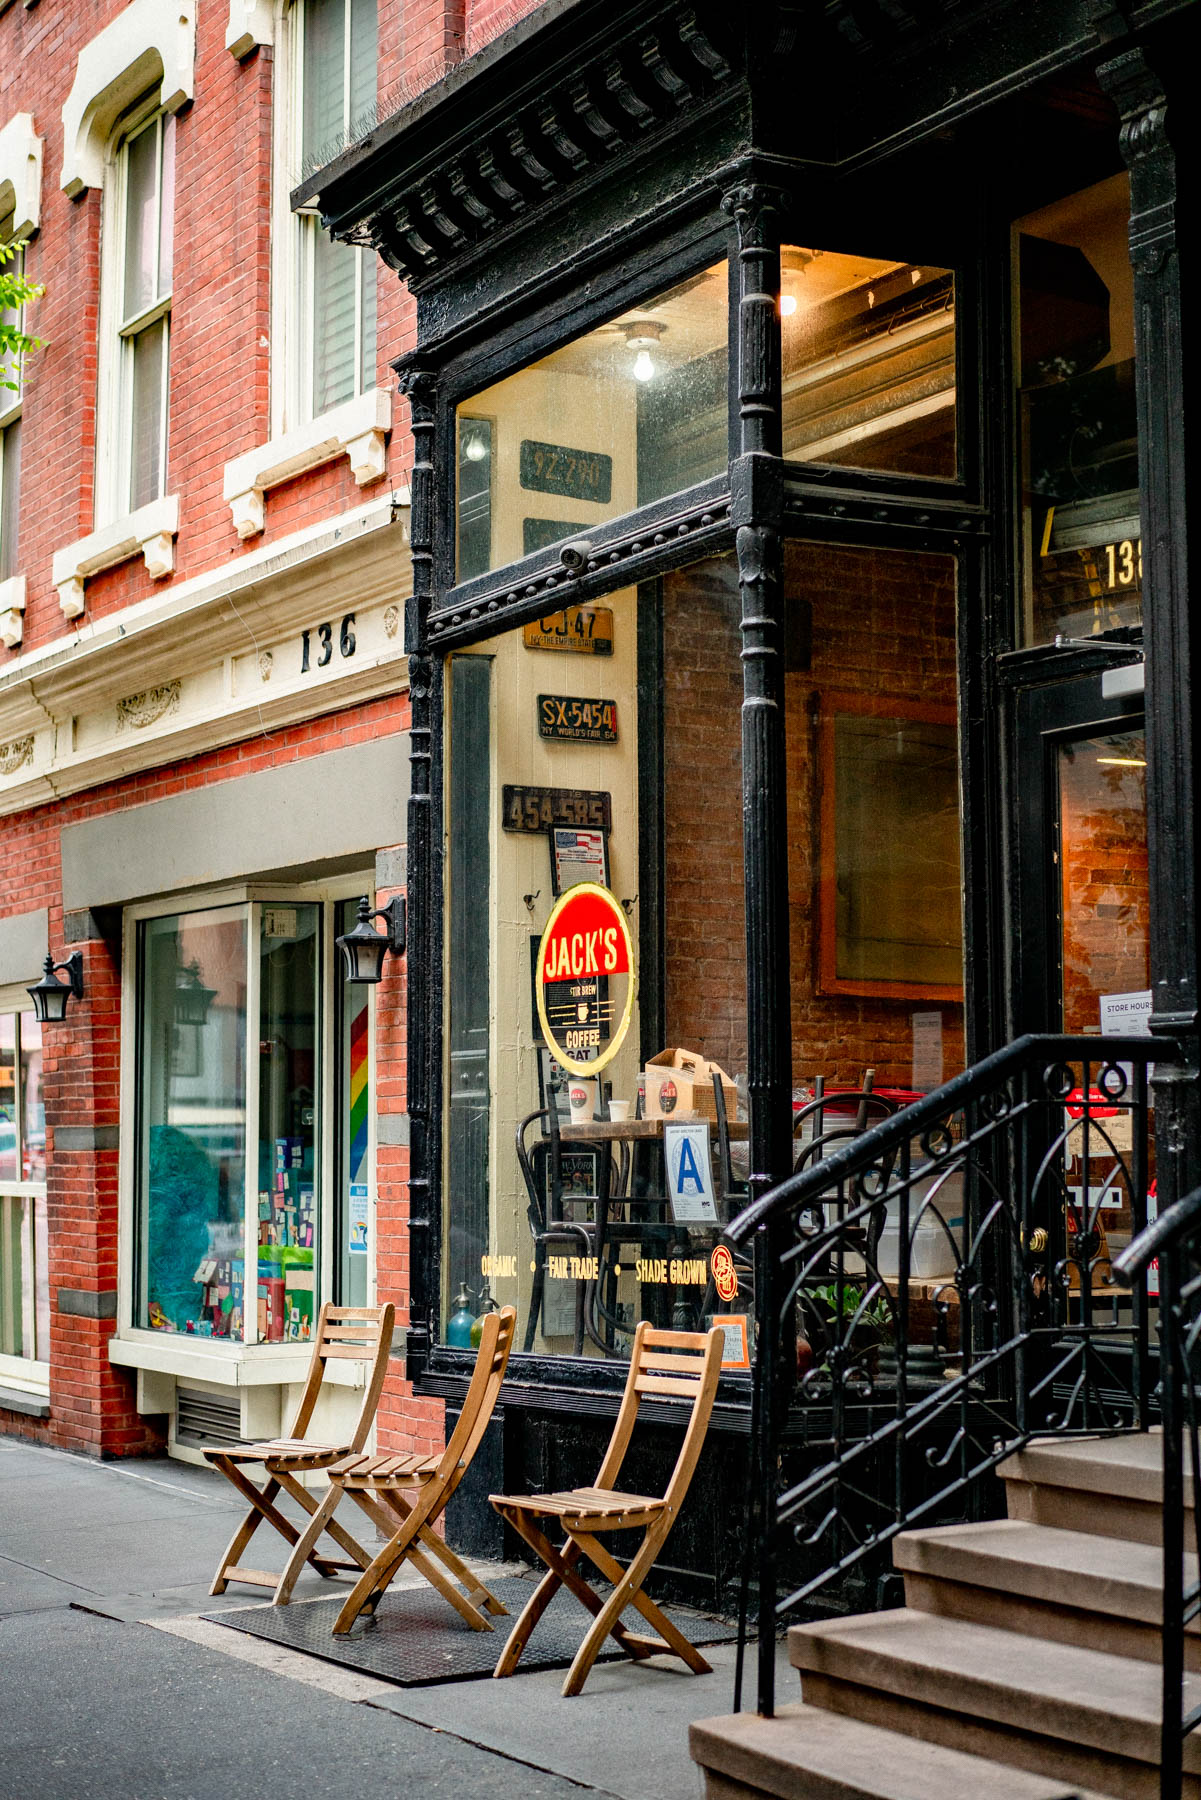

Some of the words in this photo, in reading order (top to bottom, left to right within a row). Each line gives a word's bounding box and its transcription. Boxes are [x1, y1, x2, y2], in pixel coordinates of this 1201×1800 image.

[301, 613, 356, 673] 136
[587, 729, 601, 738] FAIR
[546, 927, 618, 978] JACK'S
[570, 986, 581, 997] STIR
[581, 984, 596, 996] BREW
[1107, 1003, 1128, 1013] STORE
[566, 1029, 600, 1048] COFFEE
[677, 1138, 705, 1193] A
[481, 1256, 517, 1277] ORGANIC
[548, 1256, 568, 1279] FAIR
[569, 1257, 599, 1280] TRADE
[635, 1259, 668, 1283] SHADE
[669, 1260, 707, 1285] GROWN
